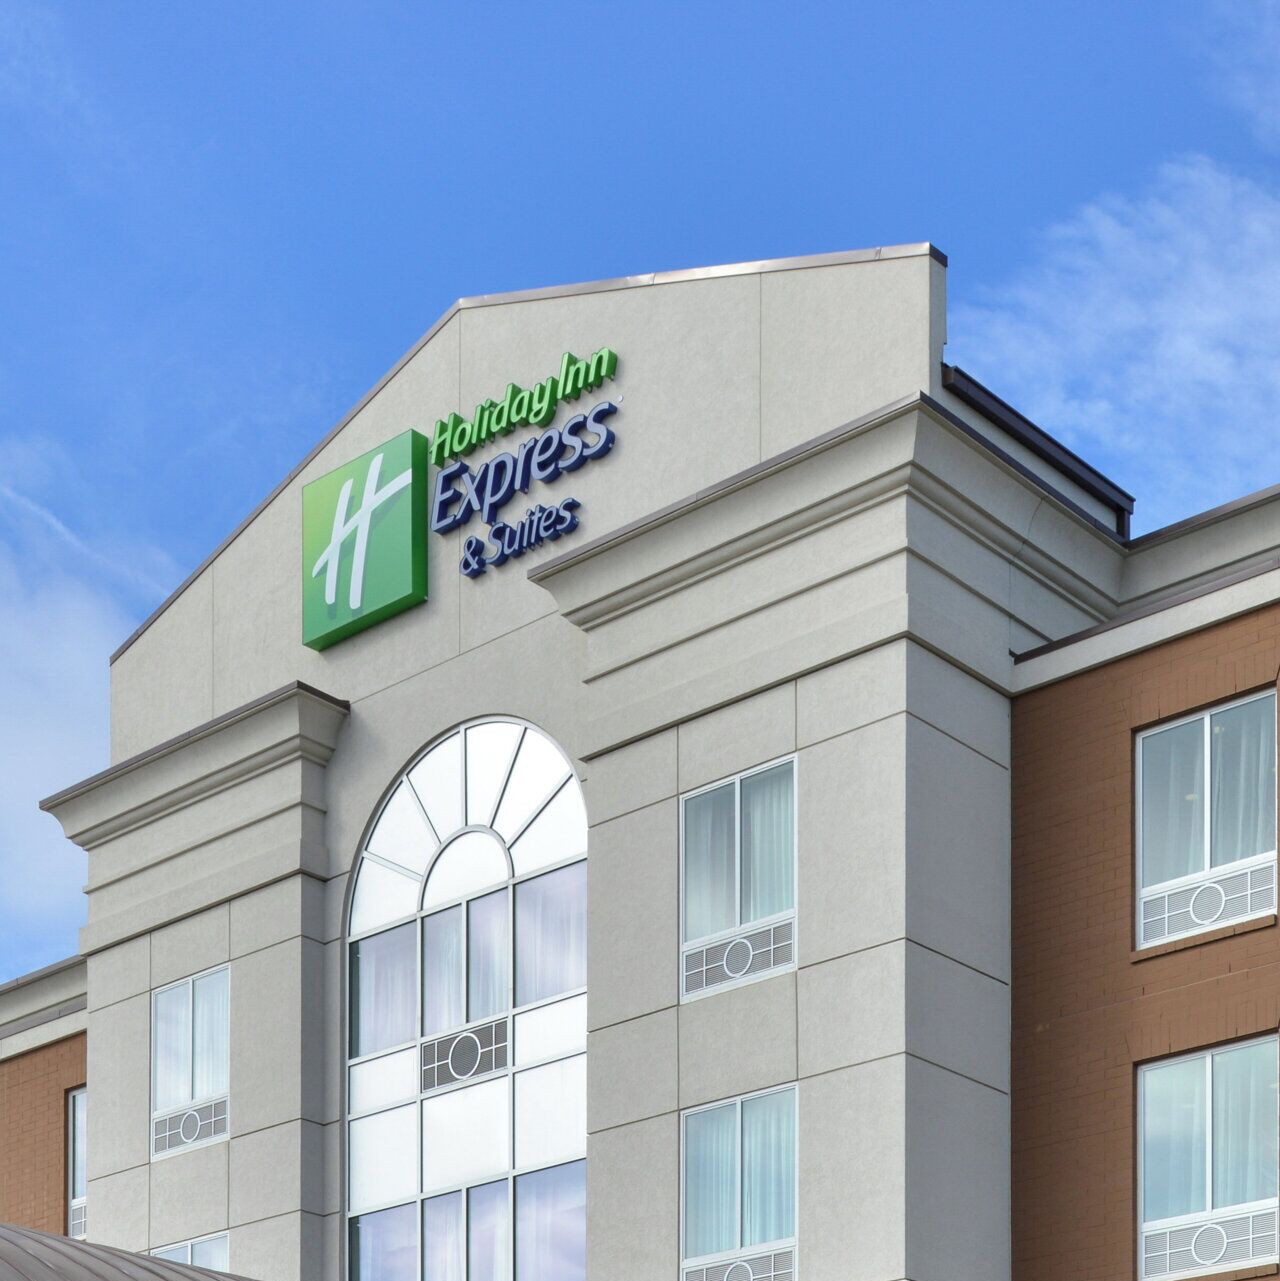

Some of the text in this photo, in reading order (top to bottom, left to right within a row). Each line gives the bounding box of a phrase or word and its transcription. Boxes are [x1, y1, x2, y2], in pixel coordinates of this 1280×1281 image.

[429, 347, 617, 467] Holiday Inn
[431, 402, 617, 534] Express
[459, 498, 581, 579] & Suites
